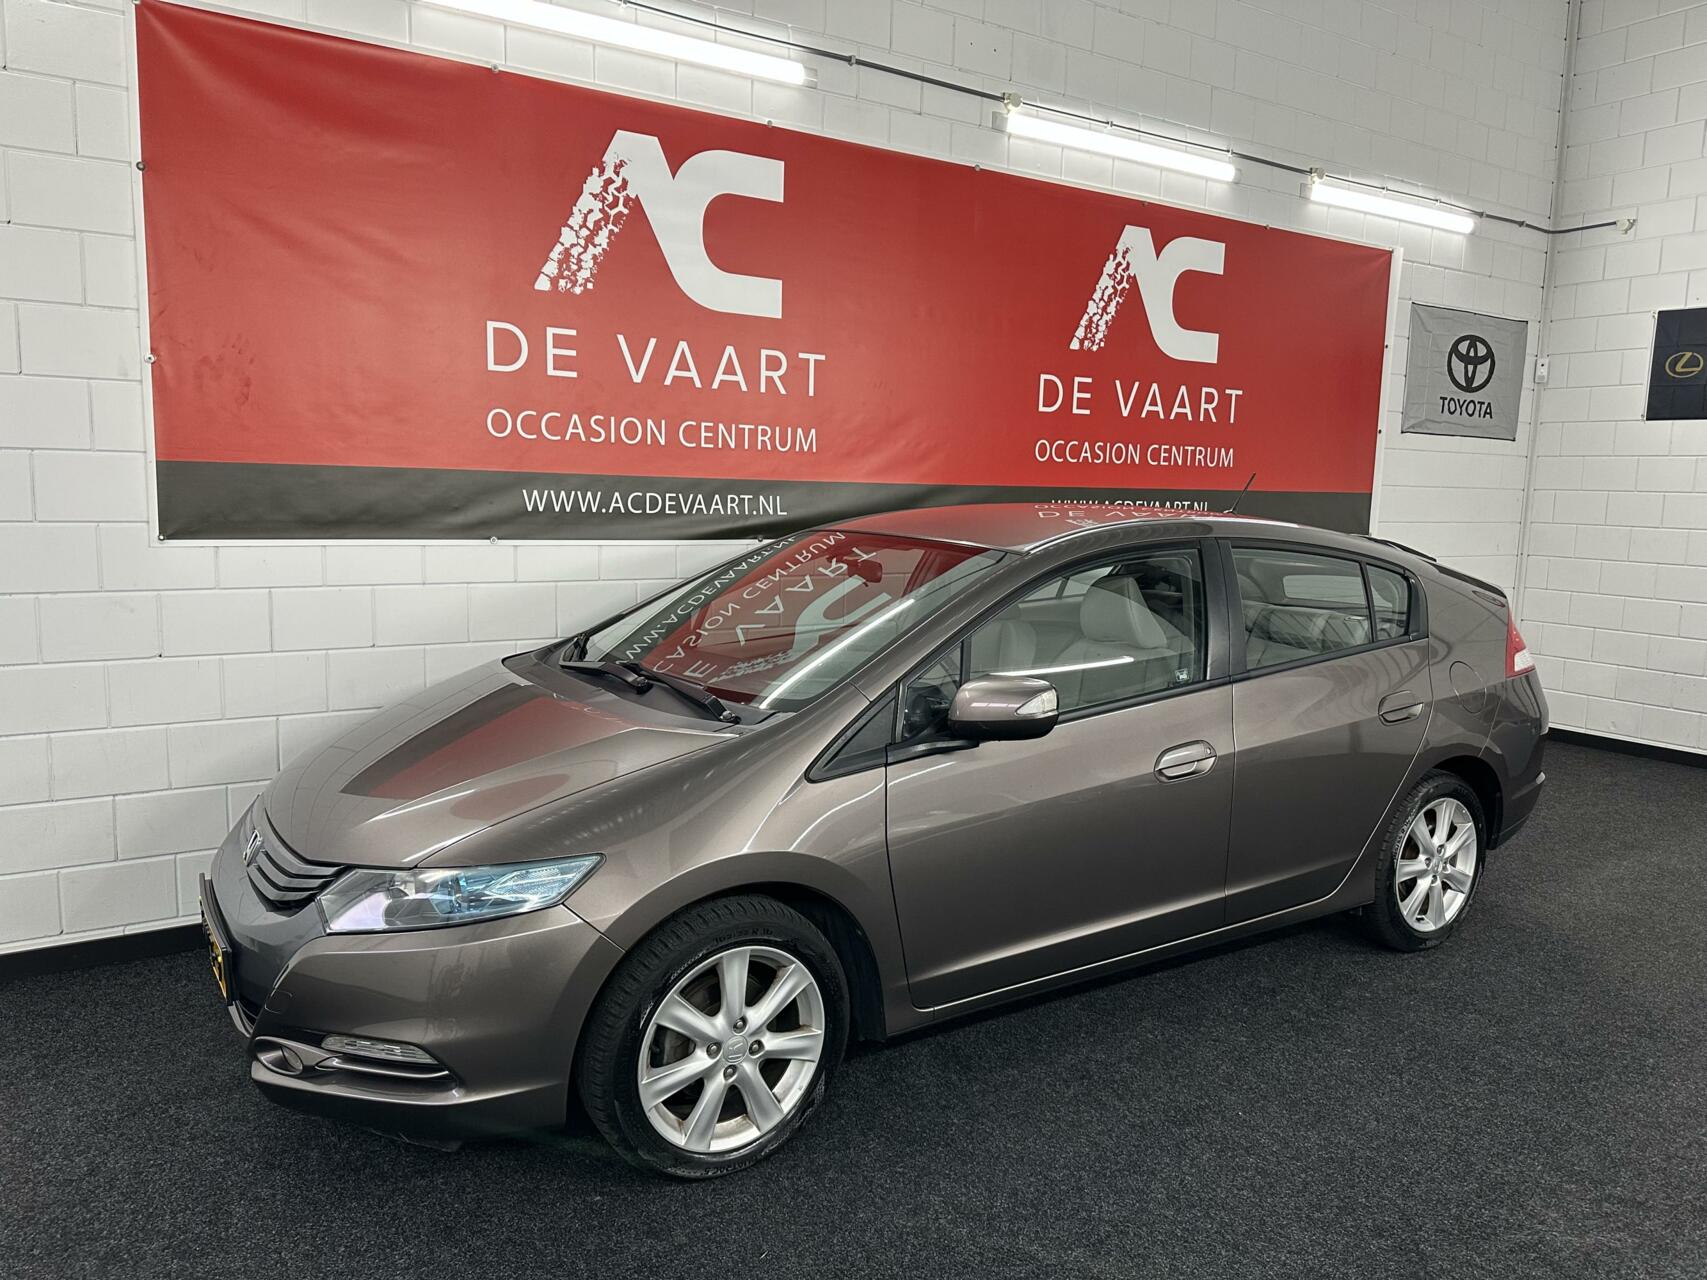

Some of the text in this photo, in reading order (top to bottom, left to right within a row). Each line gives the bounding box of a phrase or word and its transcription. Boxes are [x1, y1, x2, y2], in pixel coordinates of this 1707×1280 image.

[534, 129, 785, 319] AC
[1069, 224, 1226, 364] AC
[487, 320, 826, 397] DE VAART
[1038, 373, 1243, 424] DE VAART
[1439, 396, 1493, 419] TOYOTA
[486, 408, 817, 453] OCCASION CENTRUM
[1035, 439, 1234, 468] OCCASION CENTRUM
[522, 489, 788, 516] WWW.ACDEVAART.NL
